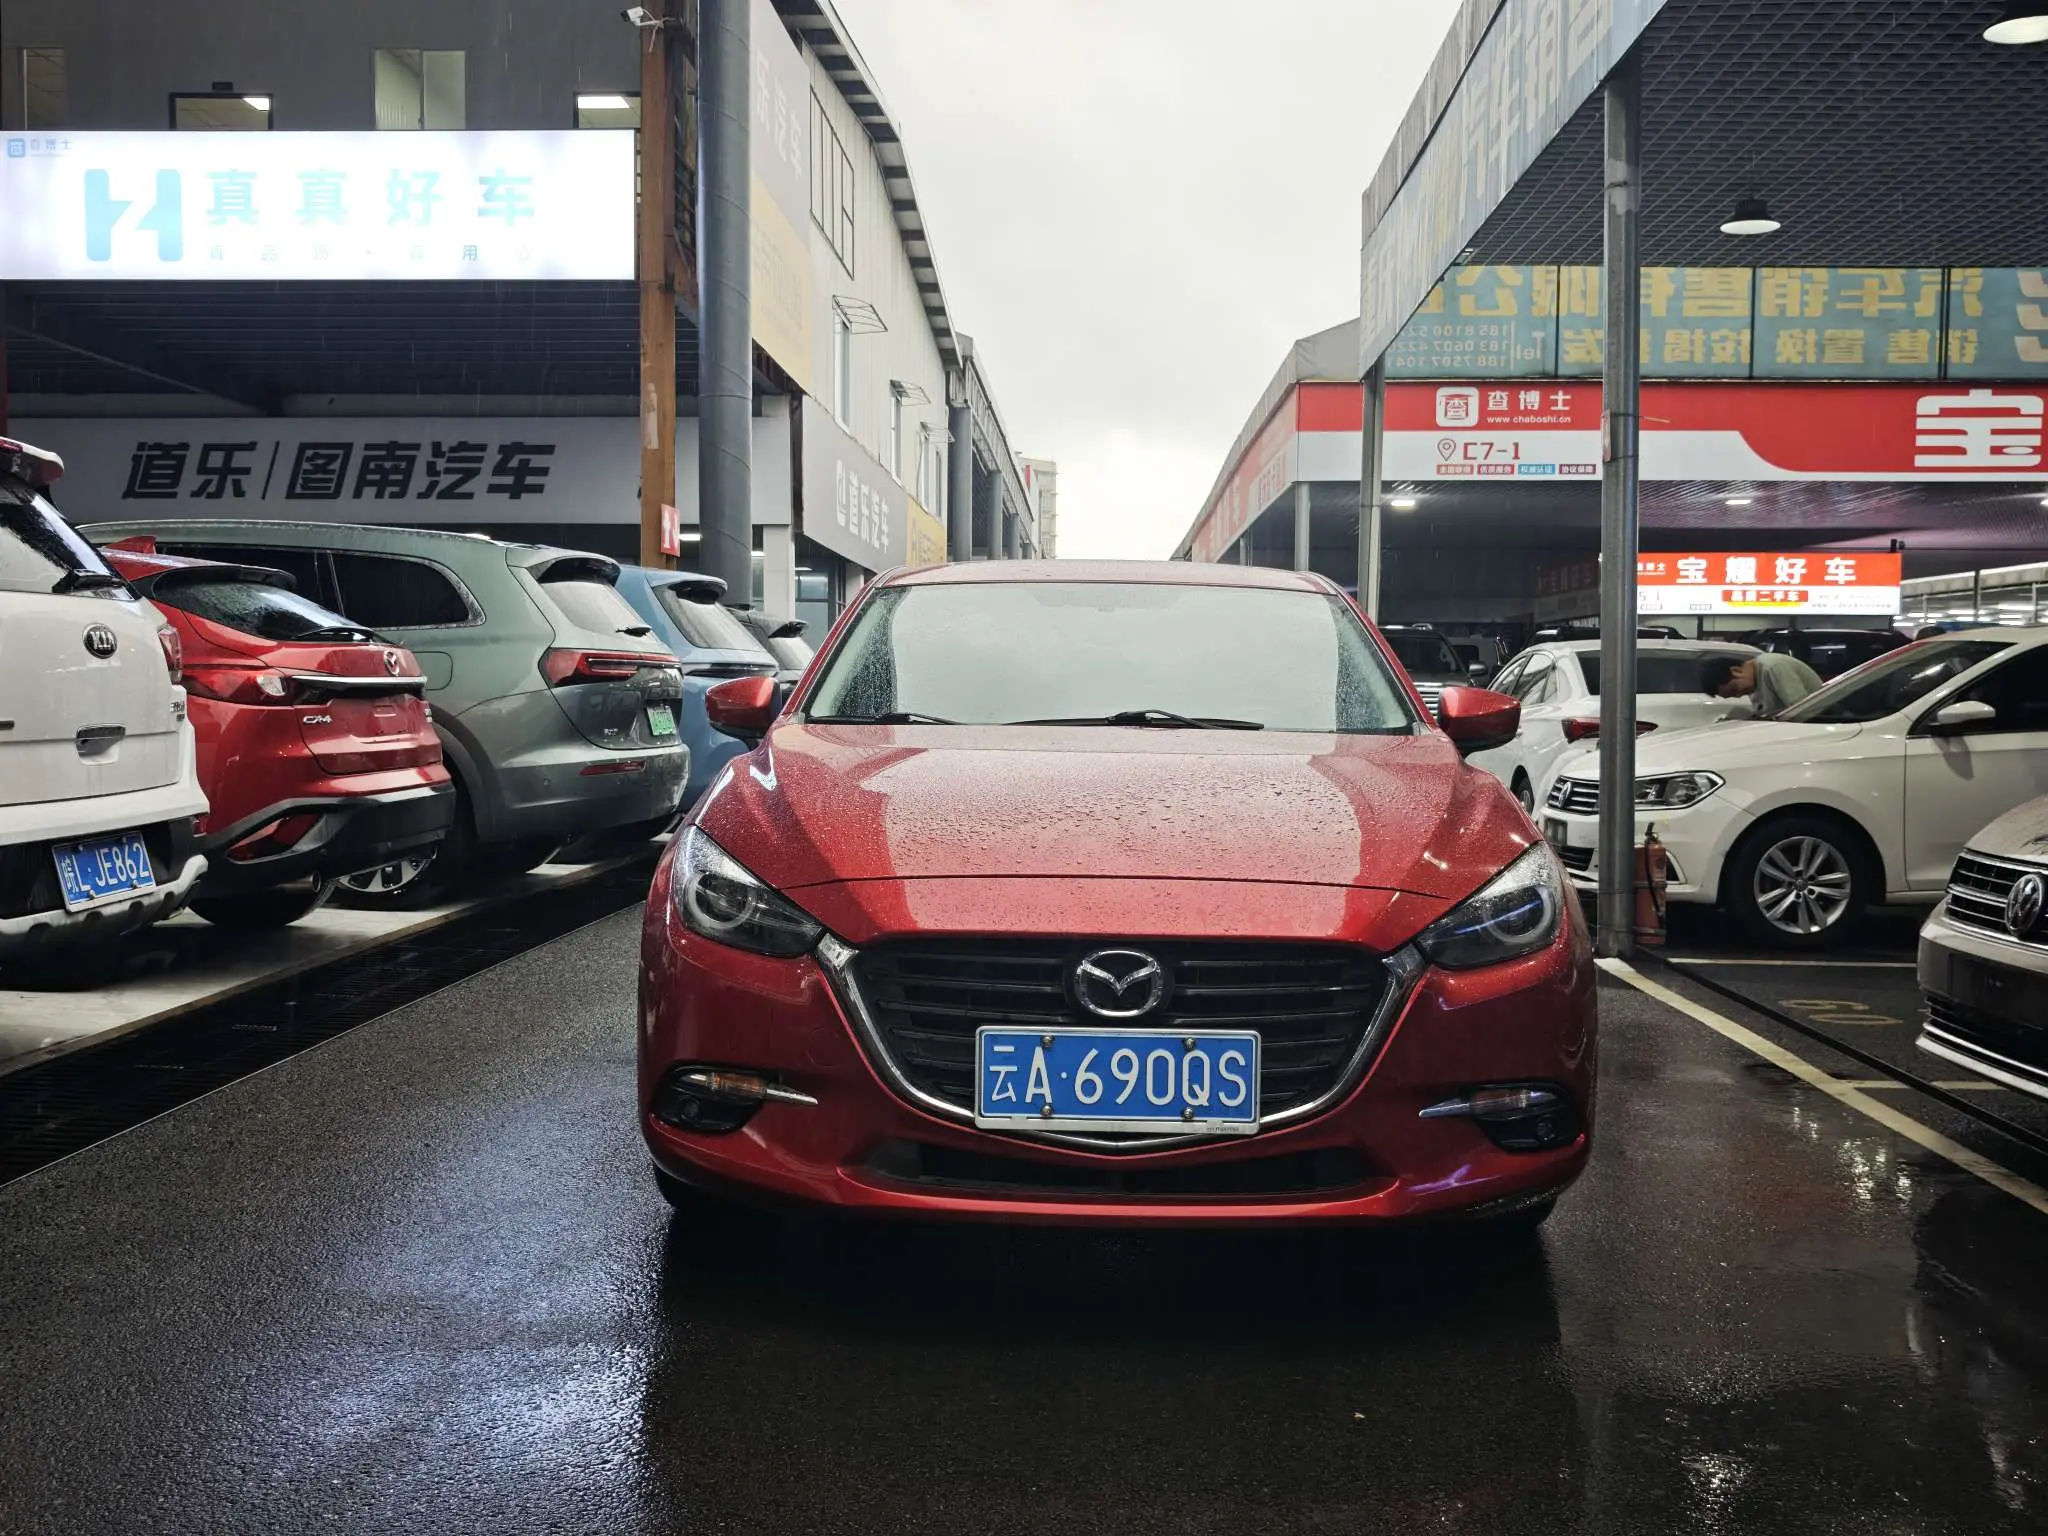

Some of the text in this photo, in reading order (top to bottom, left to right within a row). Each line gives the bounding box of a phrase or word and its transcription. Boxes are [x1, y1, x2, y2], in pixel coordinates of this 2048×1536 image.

[206, 168, 535, 227] 真真好车
[1487, 390, 1572, 411] 查博士
[1914, 388, 2044, 467] 宝
[1463, 442, 1520, 460] C7-1
